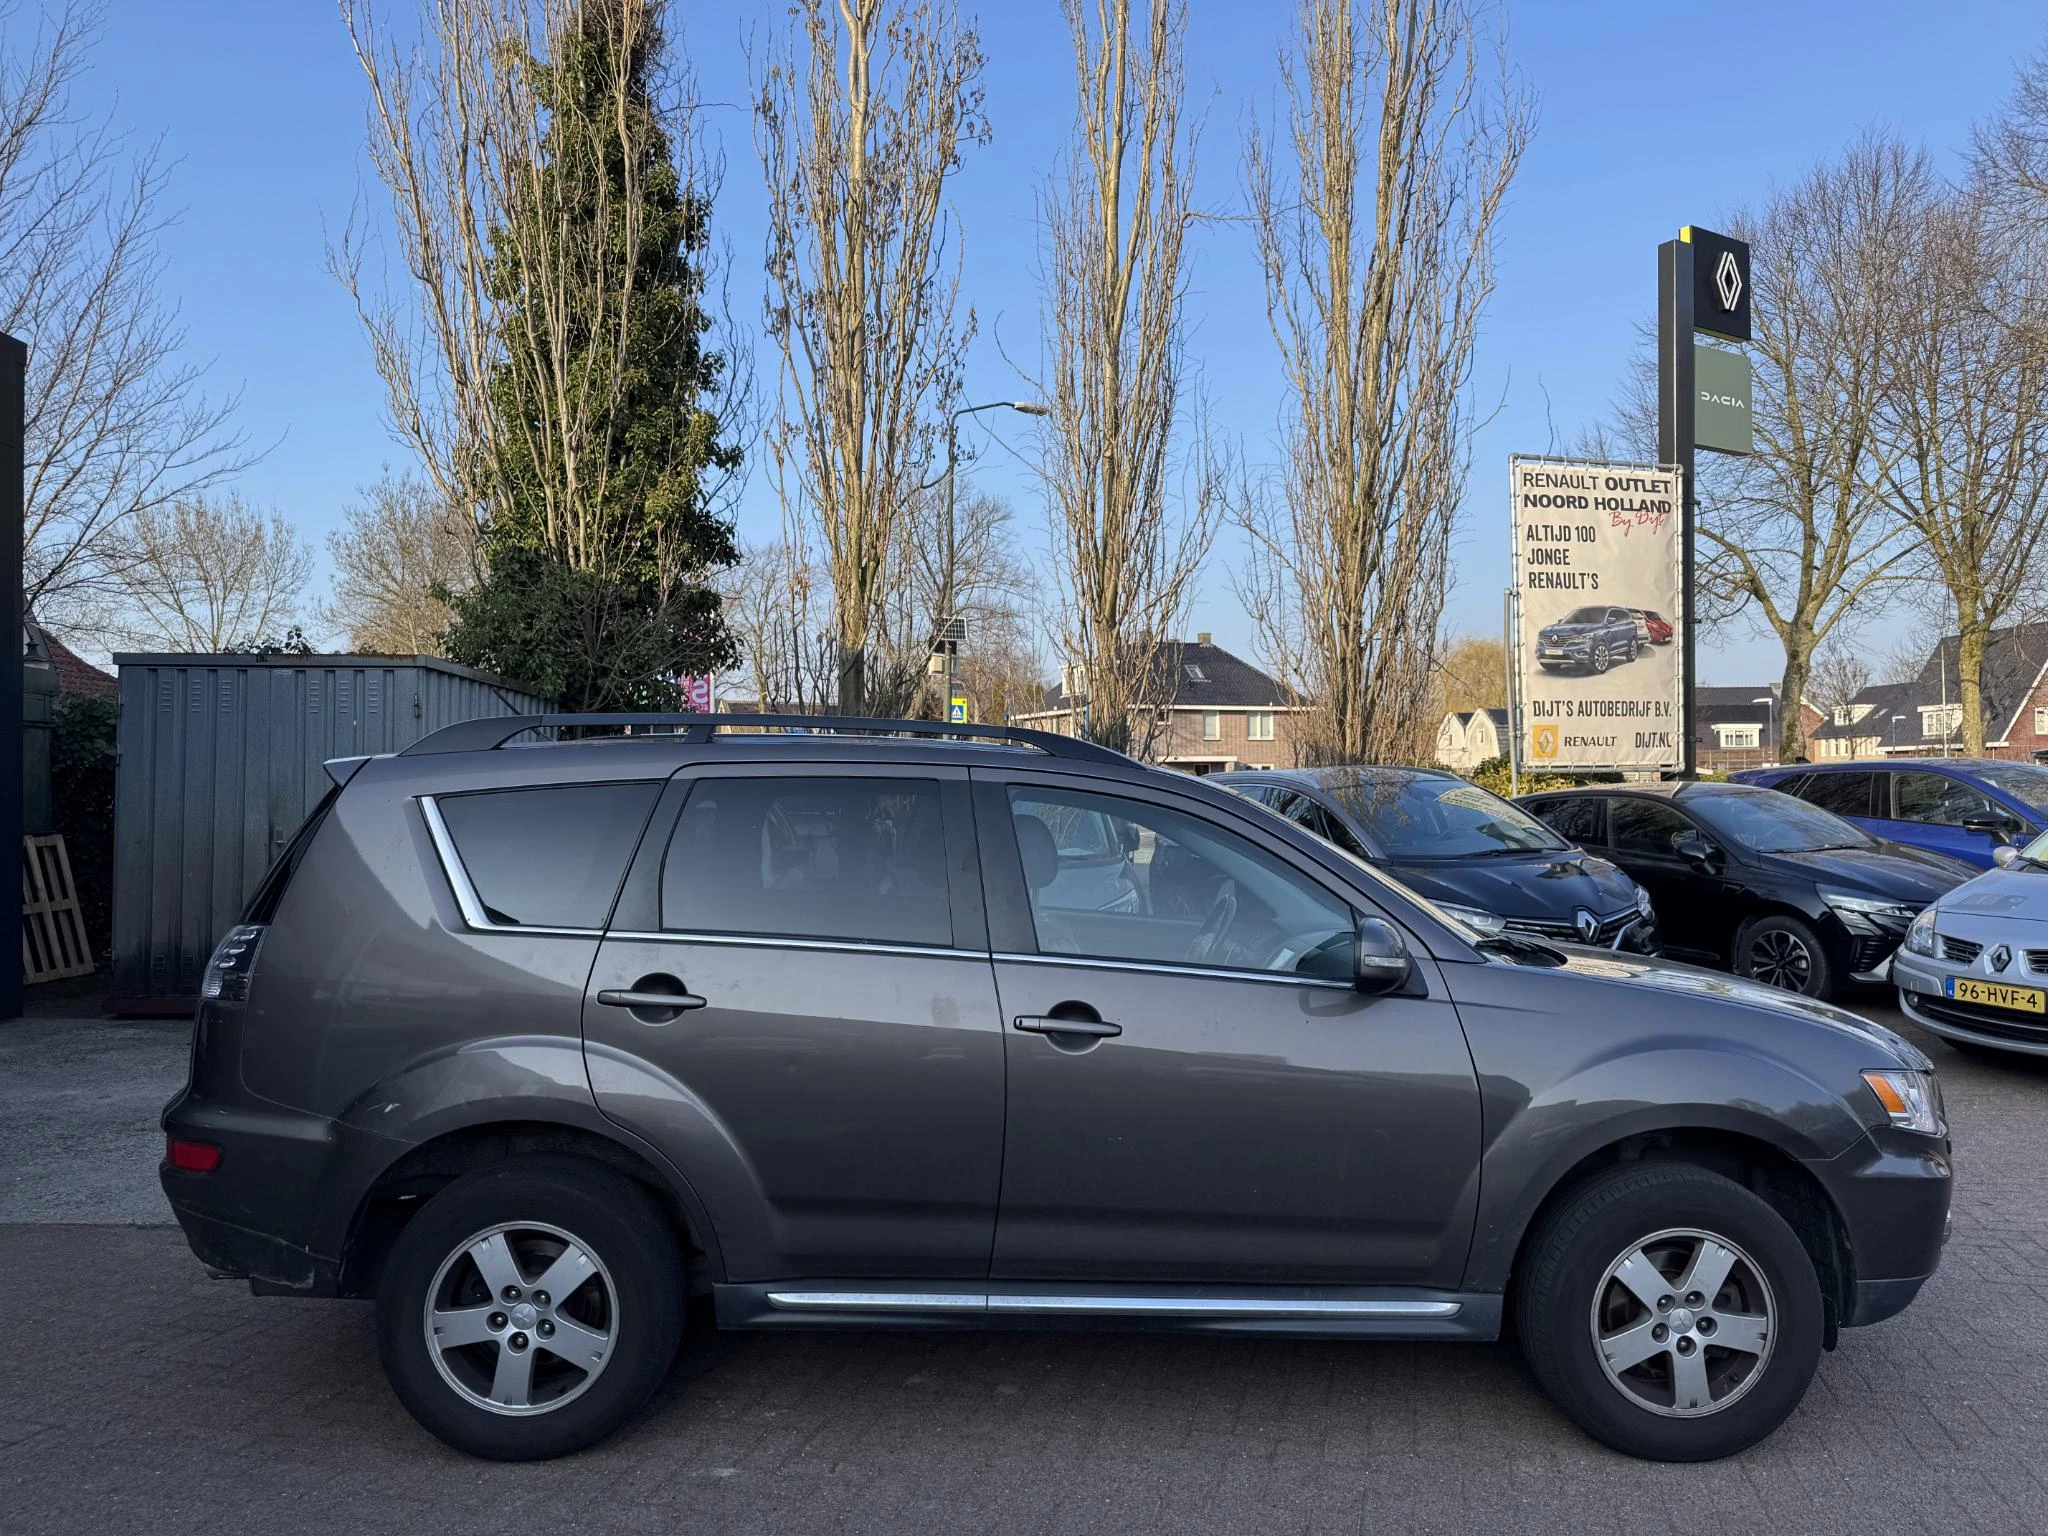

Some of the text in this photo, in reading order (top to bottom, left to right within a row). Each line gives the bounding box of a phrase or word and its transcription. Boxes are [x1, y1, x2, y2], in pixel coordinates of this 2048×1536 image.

[1701, 391, 1745, 408] DACIA
[1523, 472, 1671, 494] RENAULT OUTLET
[1523, 494, 1672, 514] NOORD HOLLAND
[1609, 511, 1632, 536] By
[1526, 524, 1596, 543] ALTIJD 100
[1527, 548, 1570, 566] JONGE
[1529, 571, 1599, 590] RENAULT'S
[1533, 700, 1672, 717] DIJT'S AUTOBEDRIJF B.V.
[1564, 731, 1672, 748] RENAULT DIJT.NL
[1959, 982, 2038, 1008] 96-HVF-4
